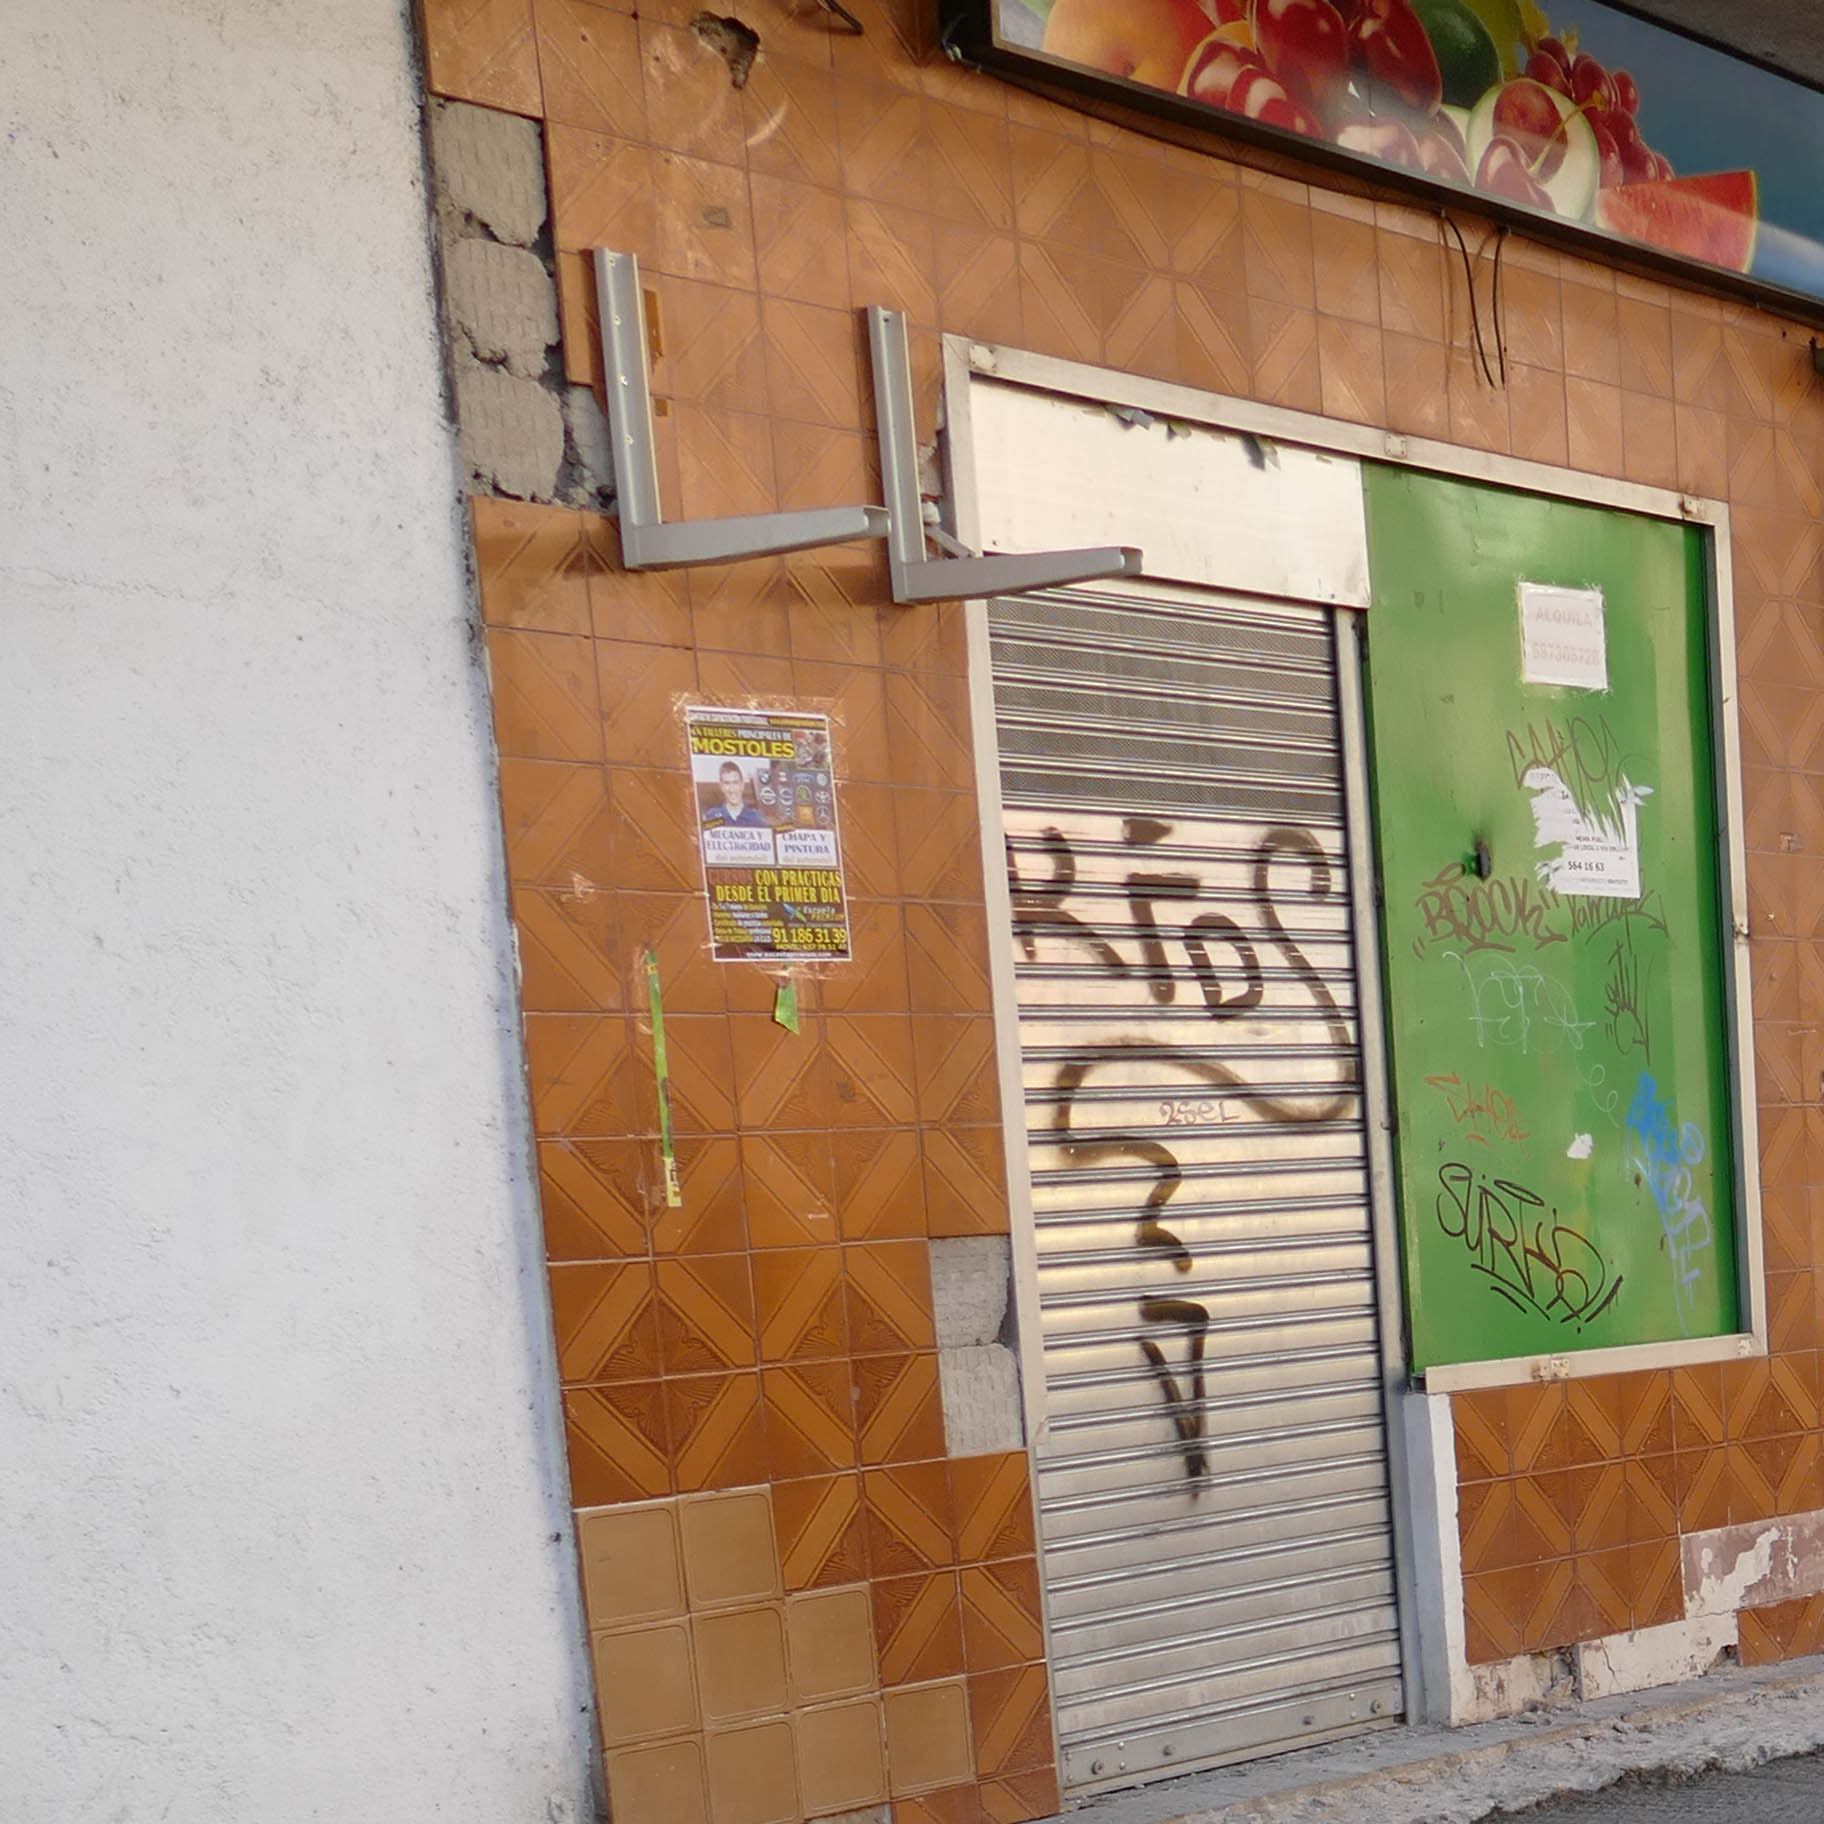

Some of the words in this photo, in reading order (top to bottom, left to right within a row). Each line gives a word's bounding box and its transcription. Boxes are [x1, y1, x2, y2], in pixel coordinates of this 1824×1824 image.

[692, 737, 796, 759] MOSTOLES
[784, 843, 830, 854] PINTURA
[754, 869, 779, 887] CON
[781, 869, 842, 887] PRACTICAS
[715, 884, 754, 902] DESDE
[757, 885, 772, 902] EL
[775, 886, 818, 903] PRIMER
[820, 887, 841, 904] DIA
[772, 927, 788, 943] 91
[790, 928, 813, 943] 186
[814, 928, 831, 943] 31
[832, 928, 848, 943] 39
